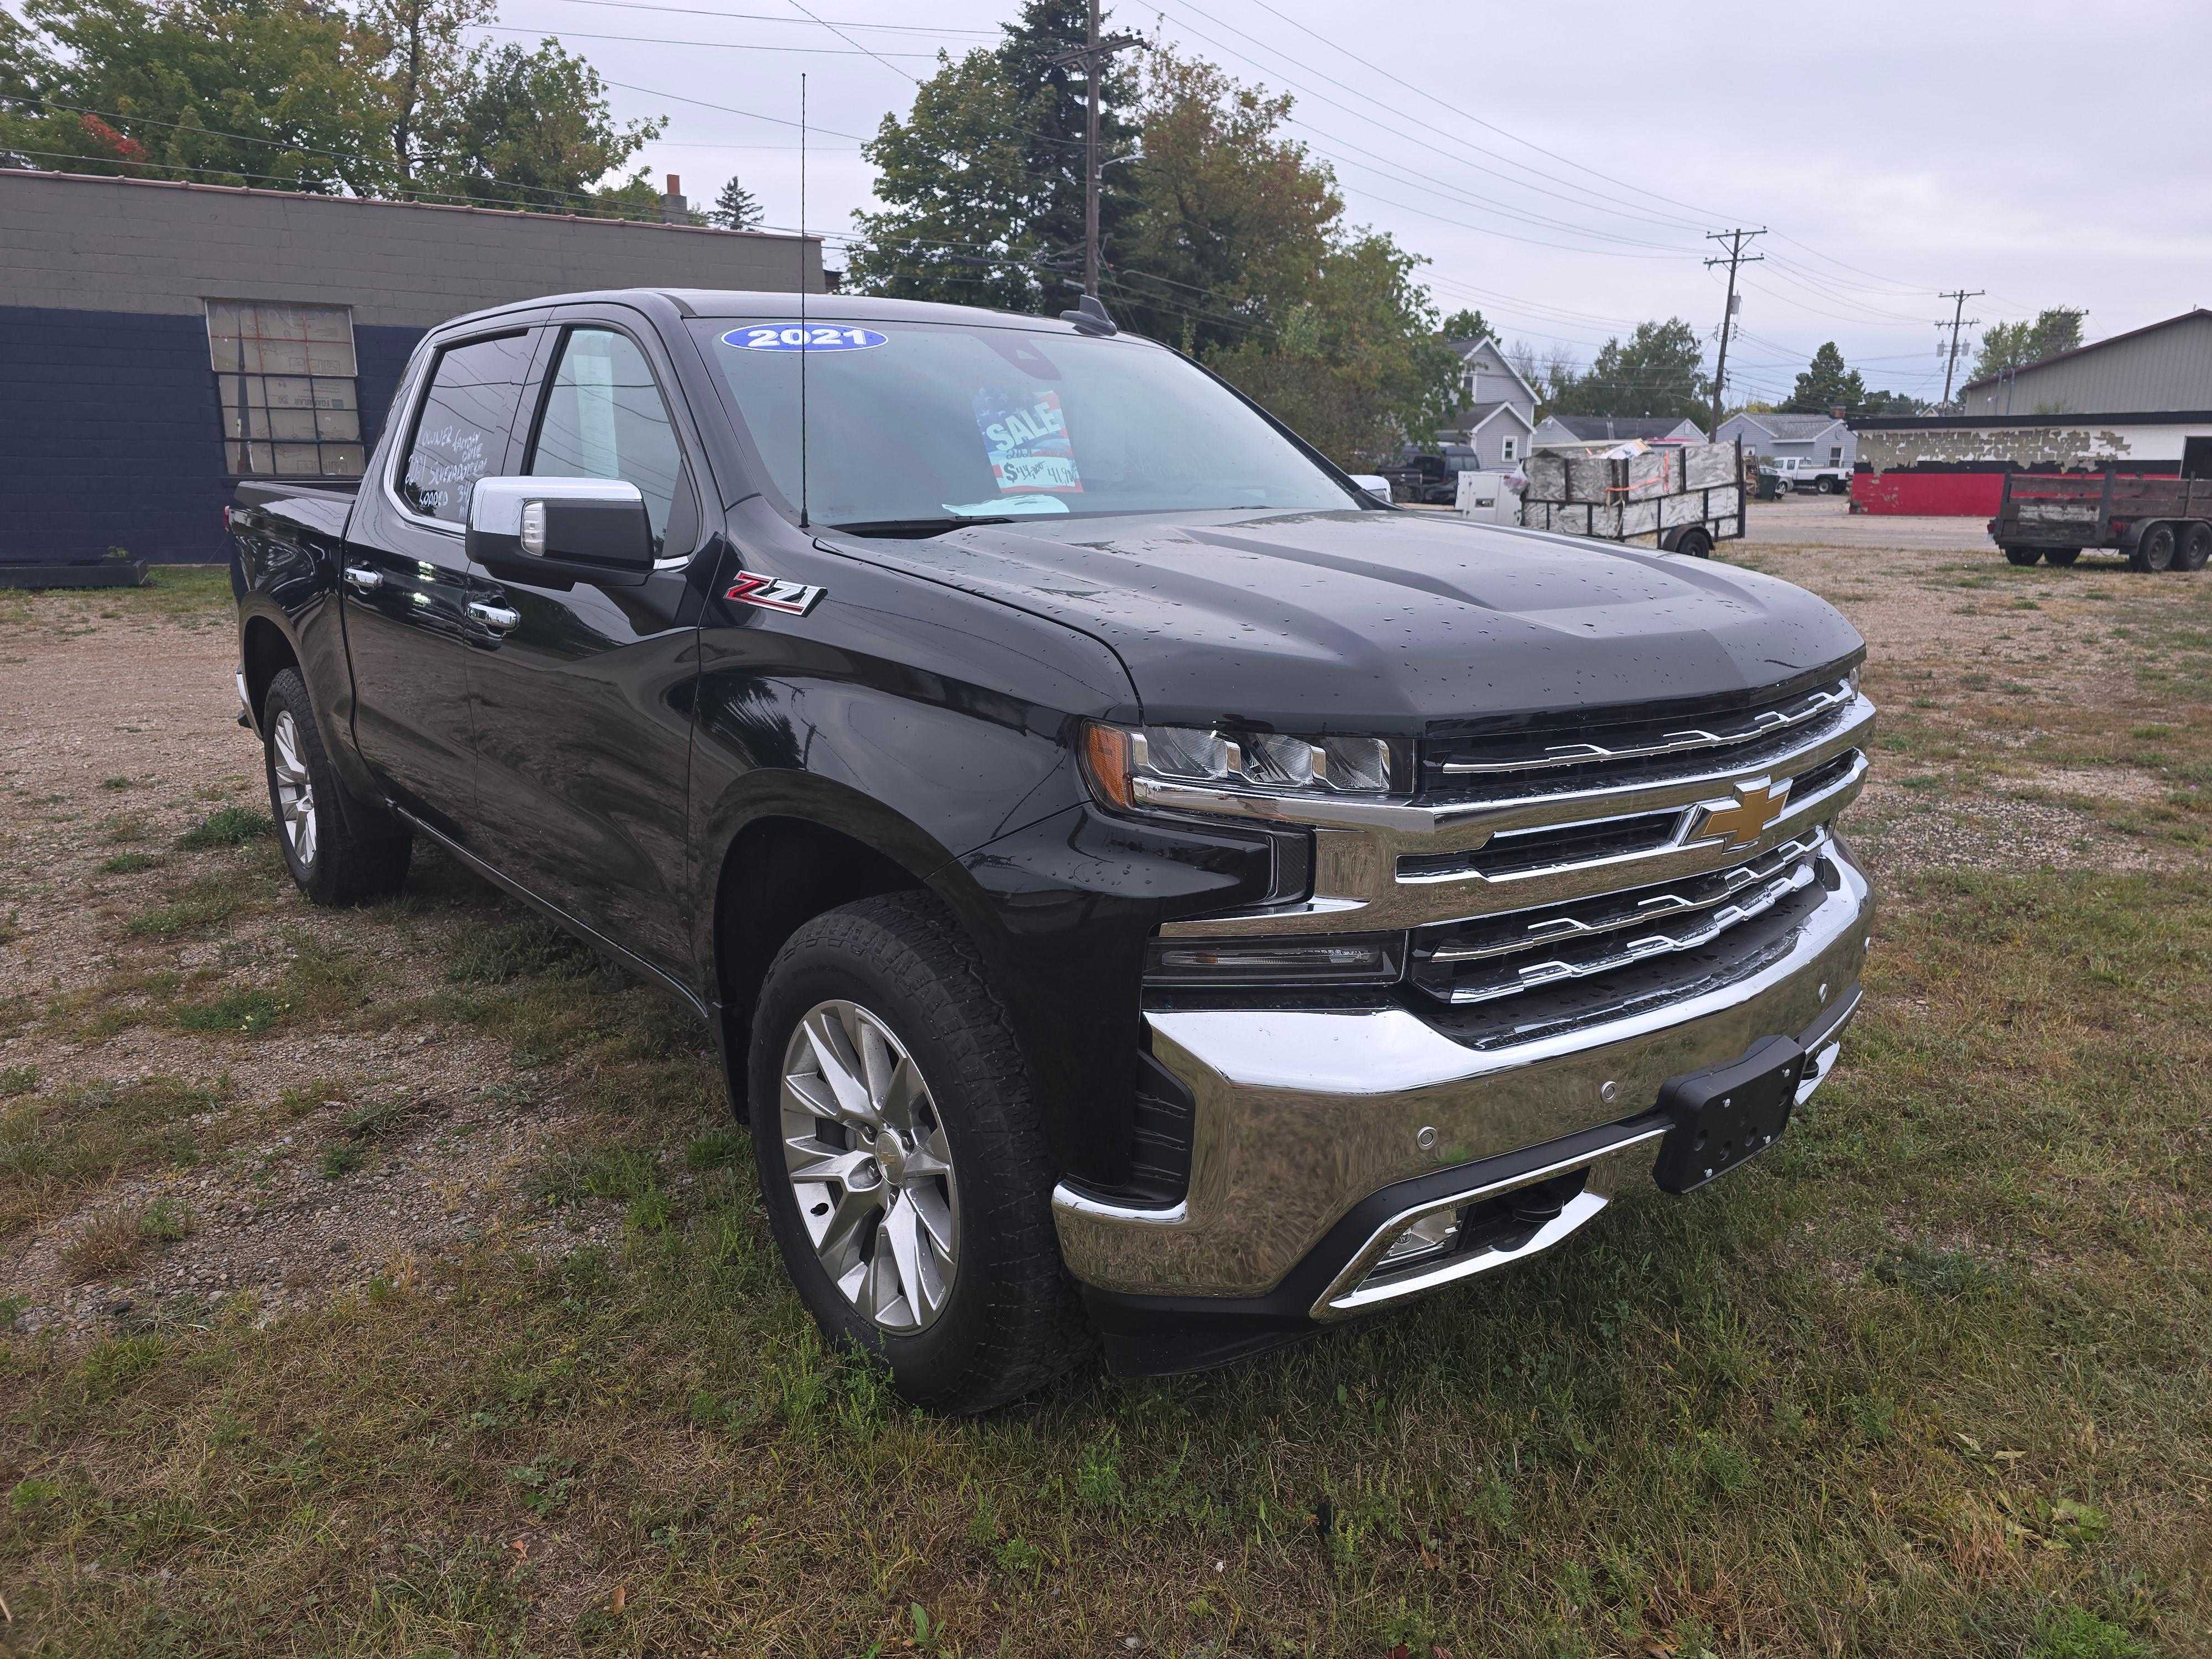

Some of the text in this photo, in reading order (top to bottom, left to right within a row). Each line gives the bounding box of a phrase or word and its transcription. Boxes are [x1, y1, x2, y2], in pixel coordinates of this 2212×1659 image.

[748, 329, 867, 347] 2021
[422, 425, 452, 446] OWNER
[987, 402, 1061, 451] SALE
[419, 487, 448, 507] LOADED
[723, 570, 828, 618] Z71
